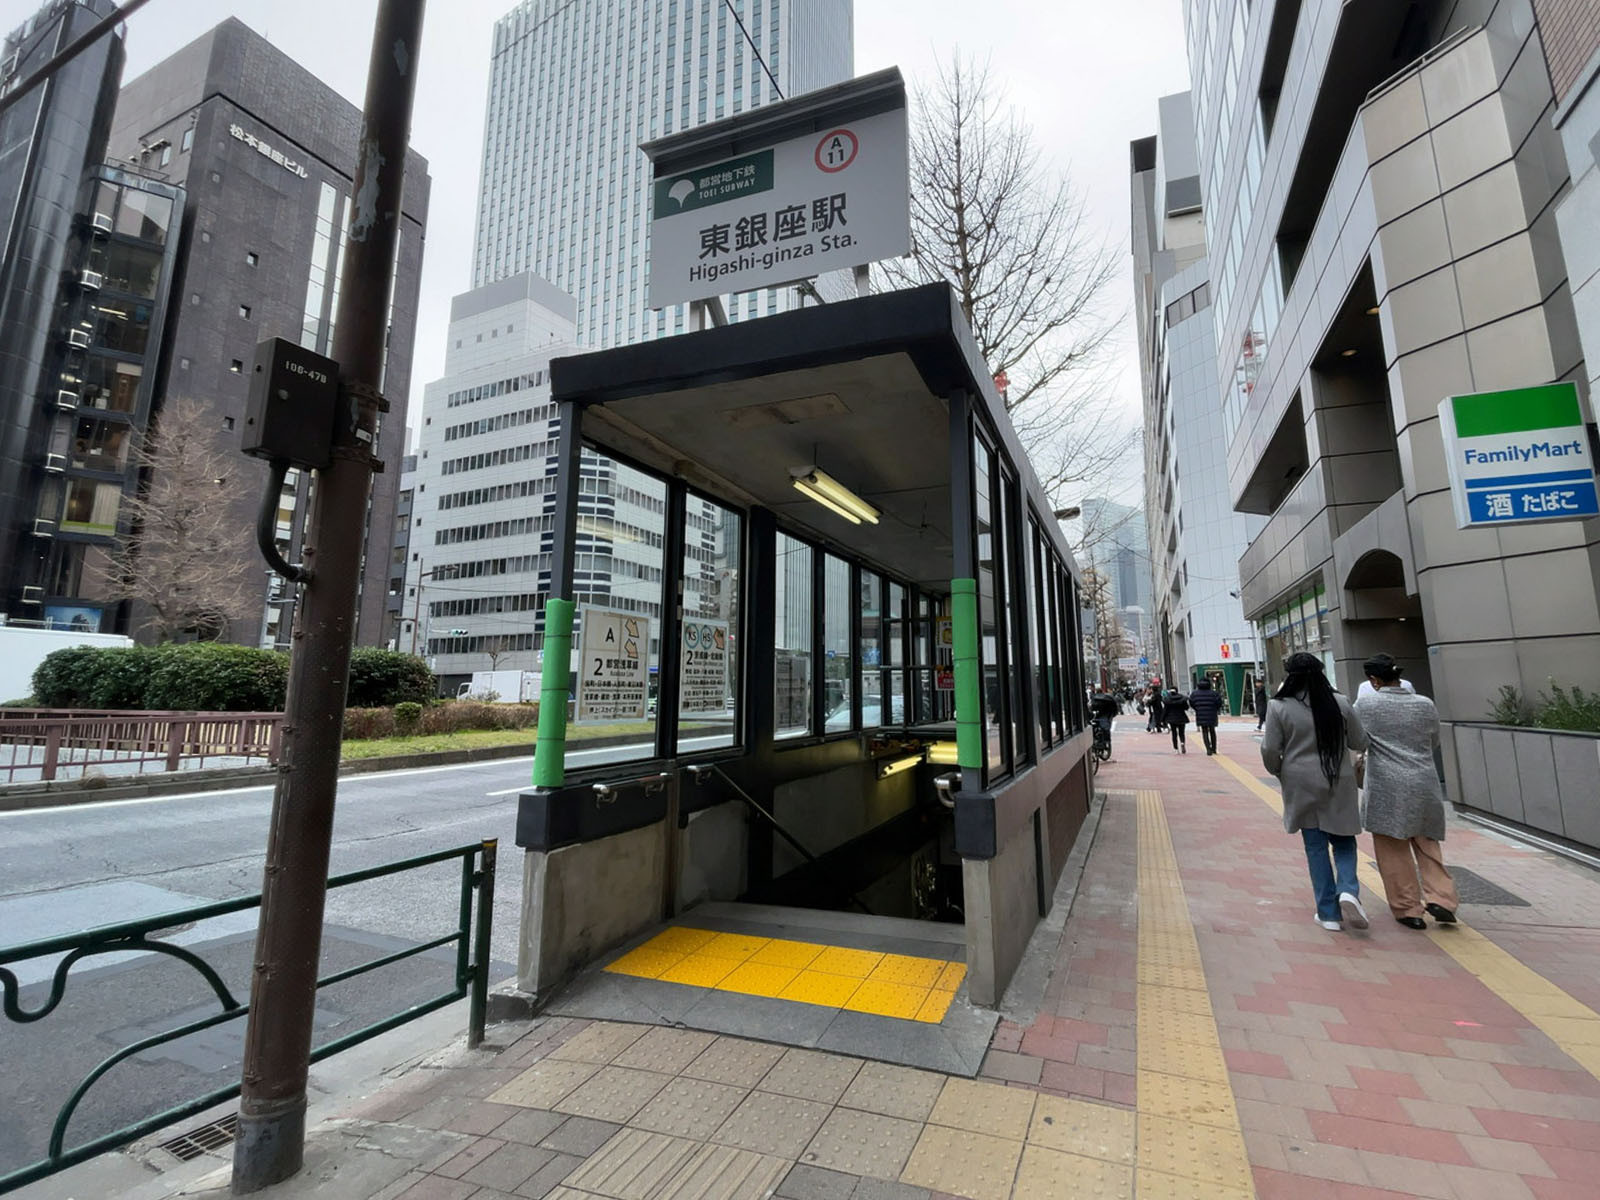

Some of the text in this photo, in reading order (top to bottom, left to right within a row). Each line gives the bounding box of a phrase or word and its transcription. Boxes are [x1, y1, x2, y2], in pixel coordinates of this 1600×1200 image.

[229, 123, 308, 178] 松本銀座ビル
[831, 137, 842, 149] A
[828, 149, 844, 165] 11
[699, 165, 756, 189] 都営地下鉄
[699, 178, 756, 199] TOEI SUBWAY
[698, 193, 848, 260] 東銀座駅
[689, 233, 858, 283] Higashi-ginza Sta.
[1464, 440, 1582, 465] FamilyMart
[1485, 491, 1579, 517] 酒 たばこ
[605, 627, 615, 643] A
[688, 631, 697, 641] KS
[703, 632, 711, 642] HS
[593, 658, 603, 676] 2
[687, 651, 693, 665] 2
